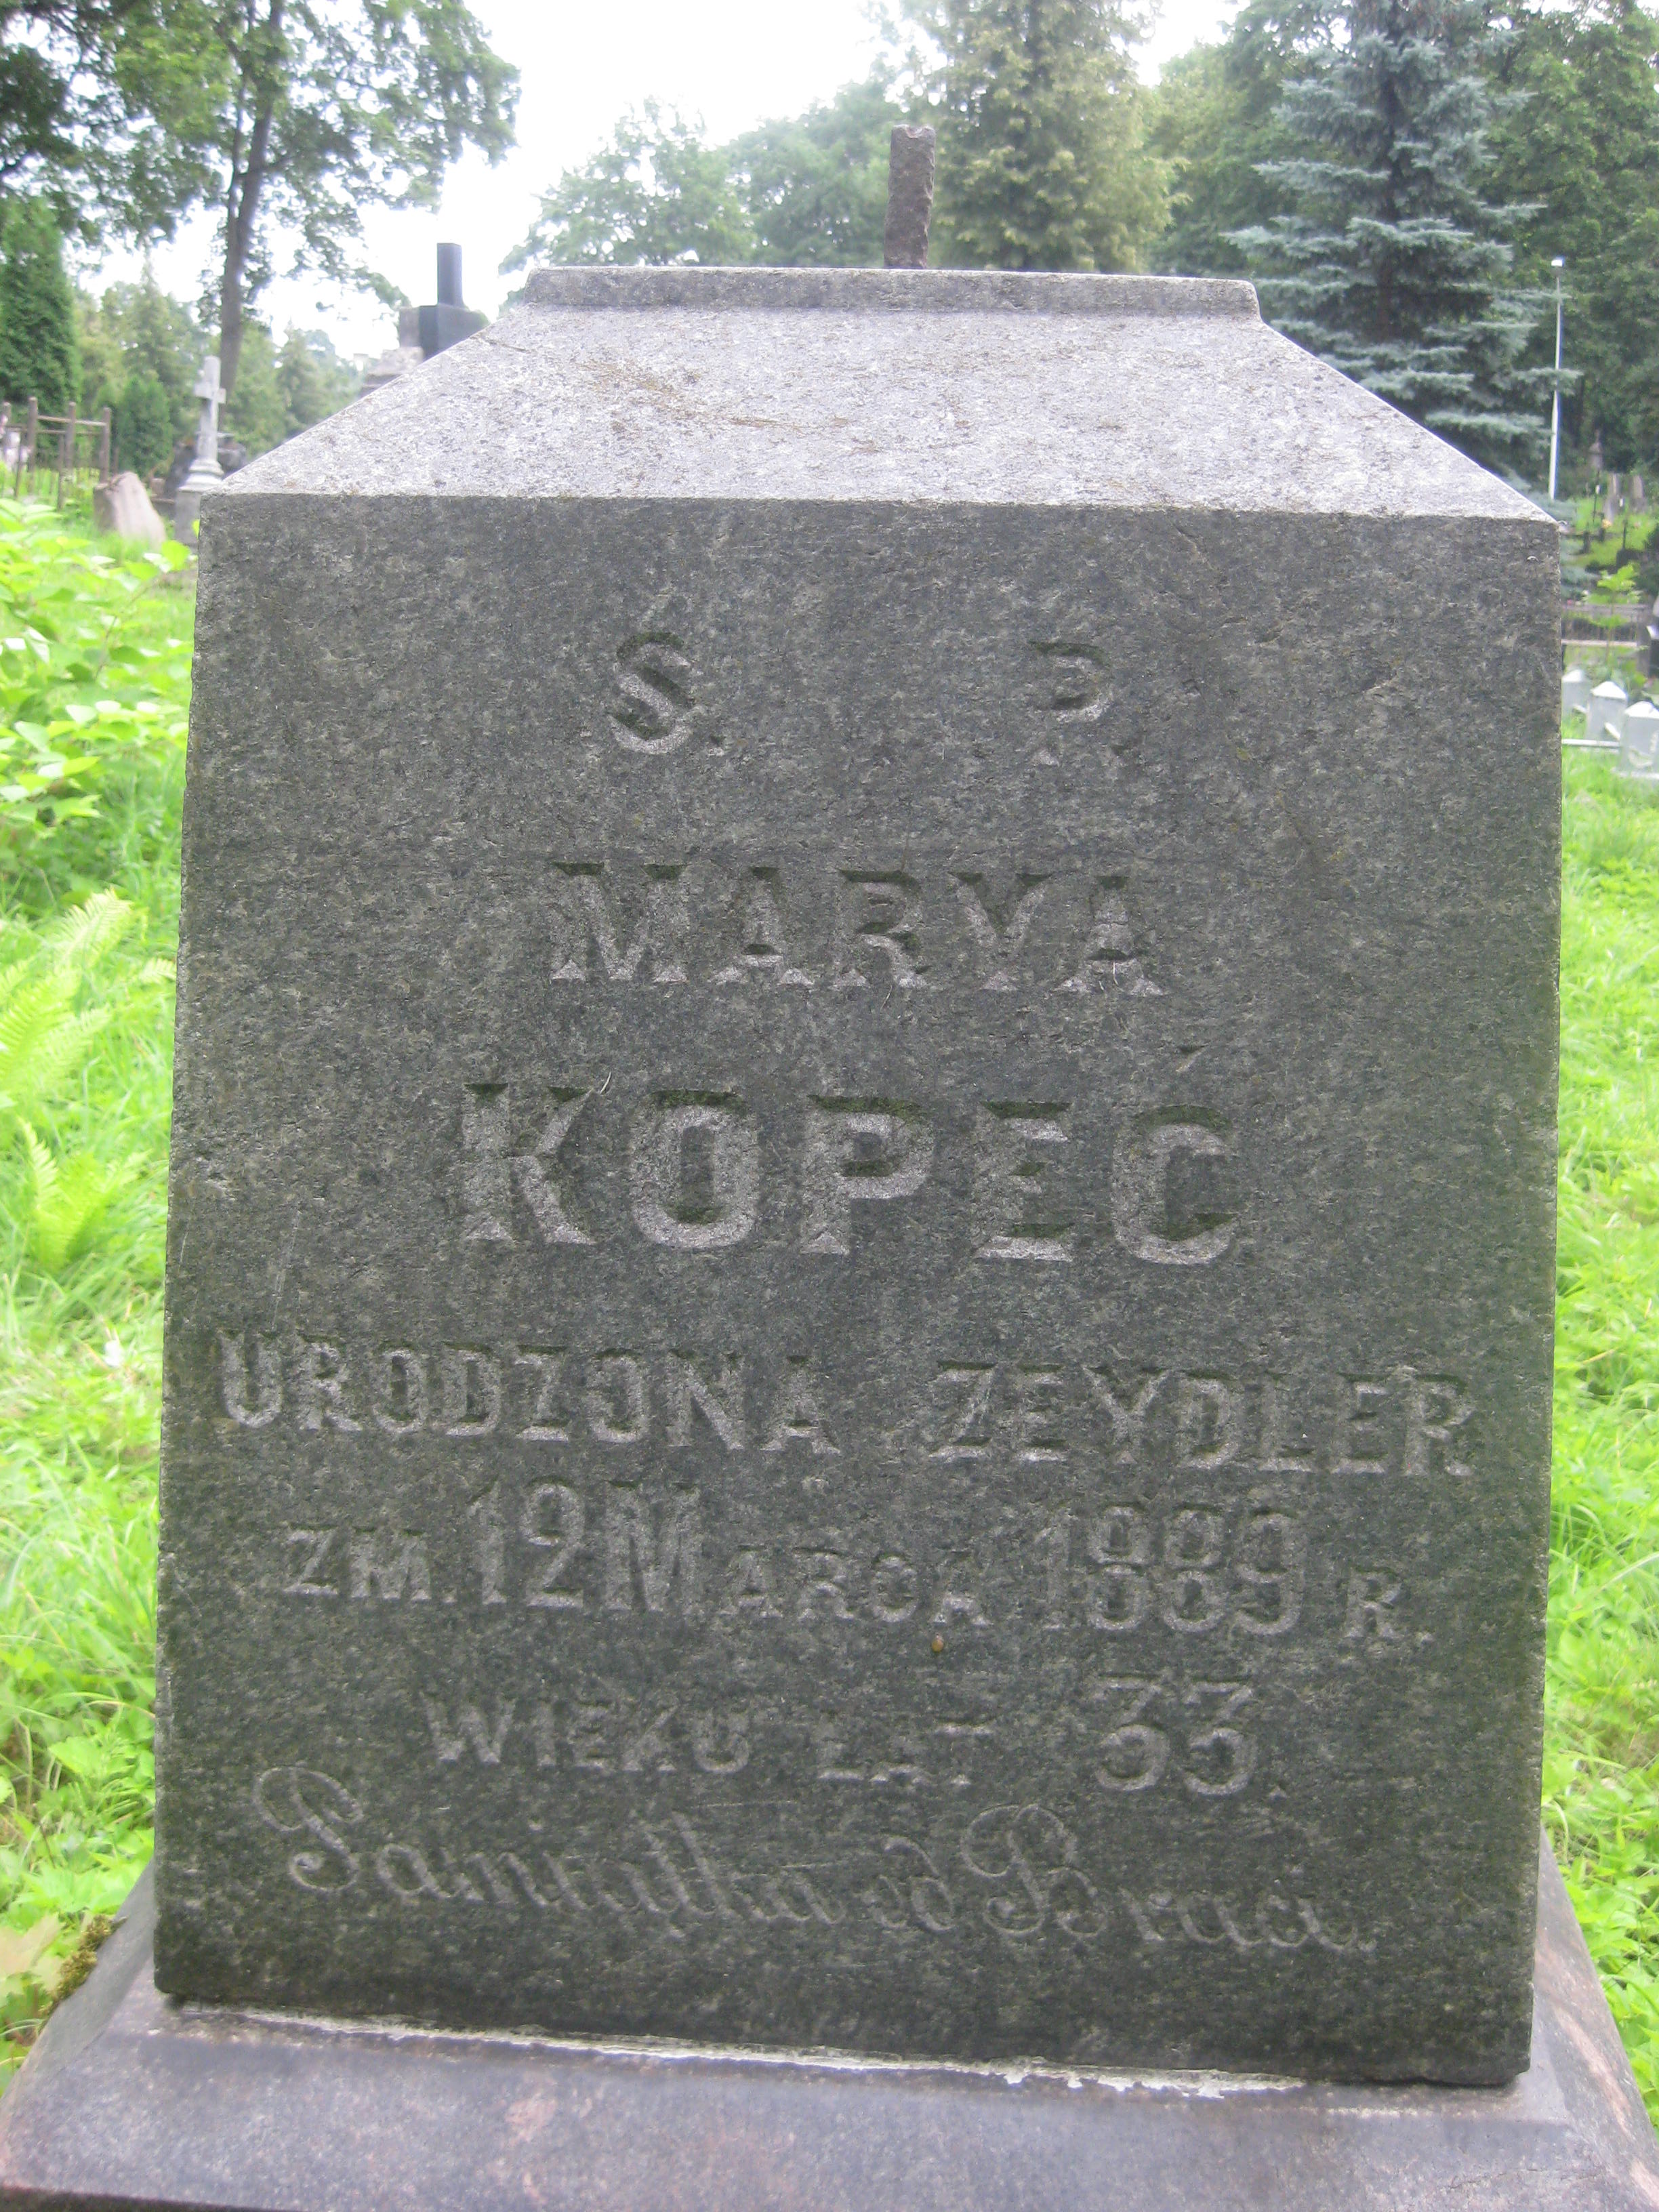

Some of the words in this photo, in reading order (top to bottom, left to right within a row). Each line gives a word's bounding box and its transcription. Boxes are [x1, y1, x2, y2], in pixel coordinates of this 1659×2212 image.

[546, 859, 1167, 996] MARYA
[216, 1328, 842, 1456] URODZONA
[930, 1358, 1476, 1479] ZEYDLER
[279, 1523, 457, 1603] ZM.
[468, 1475, 586, 1610] 12
[602, 1479, 991, 1625] MARCA
[1036, 1503, 1303, 1635] 1889
[1345, 1565, 1433, 1644] R.
[419, 1693, 750, 1773] WIEKU
[813, 1706, 996, 1785] LAT
[867, 1834, 956, 1931] od
